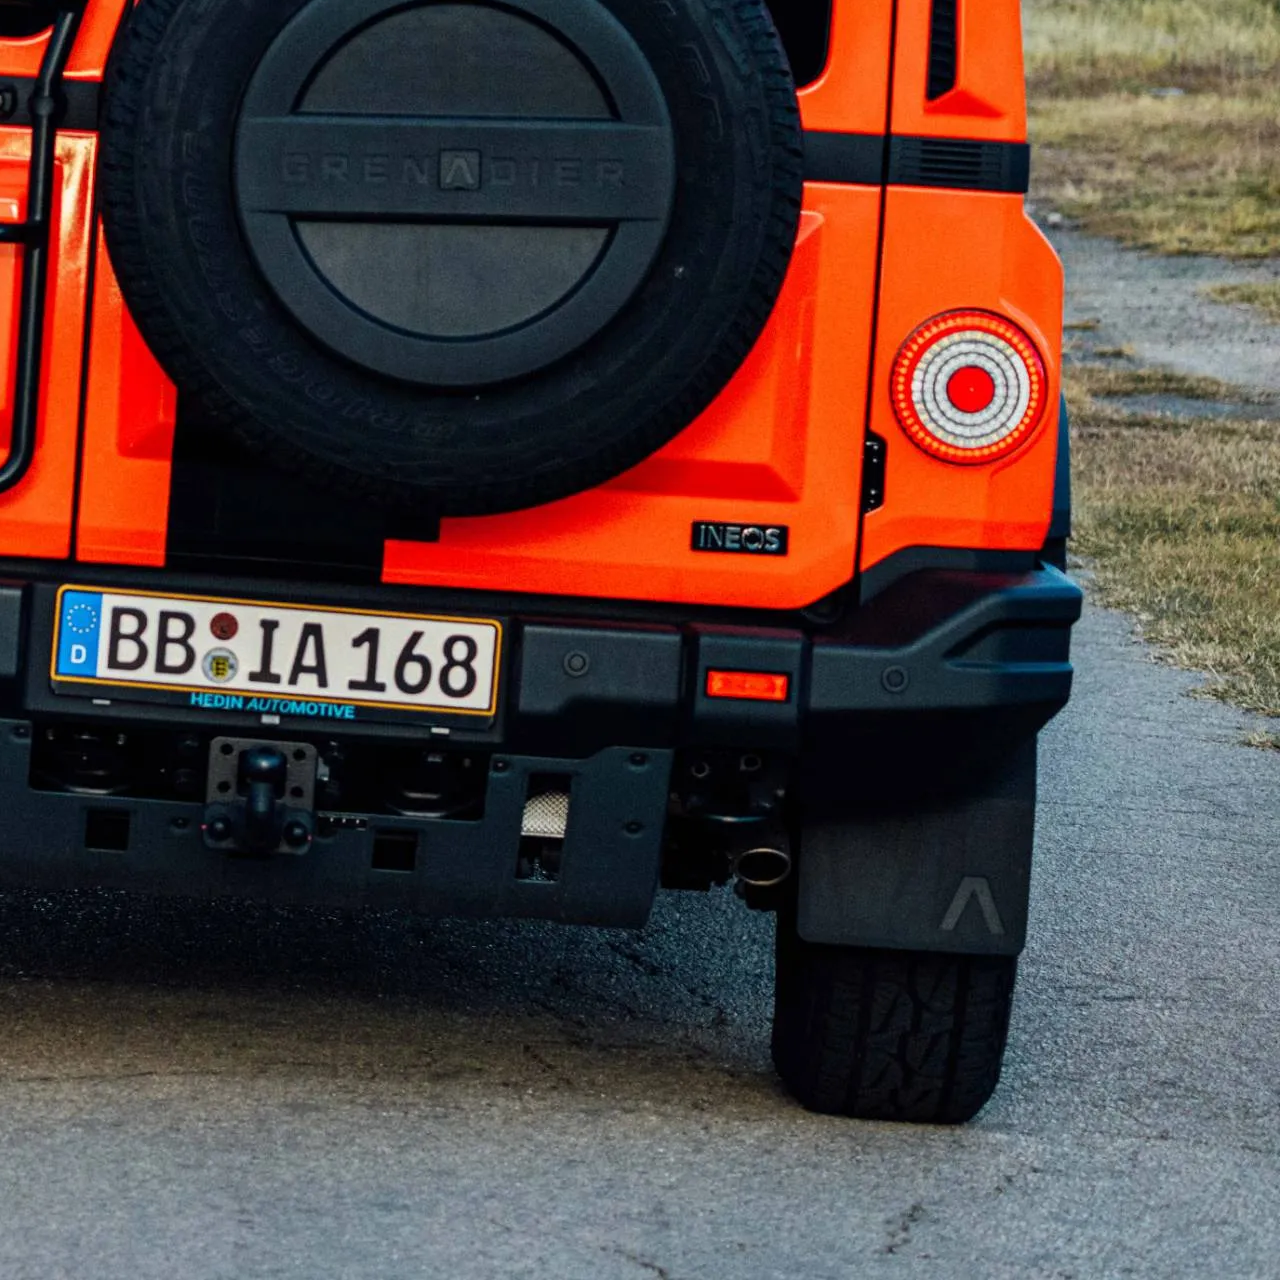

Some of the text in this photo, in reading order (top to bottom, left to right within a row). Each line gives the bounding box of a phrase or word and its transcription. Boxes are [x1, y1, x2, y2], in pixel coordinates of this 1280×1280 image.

[280, 150, 625, 188] GRENADIER
[698, 524, 781, 552] INEOS
[70, 643, 87, 665] D
[106, 606, 479, 699] BB IA 168
[190, 691, 356, 720] HEDIN AUTOMOTIVE
